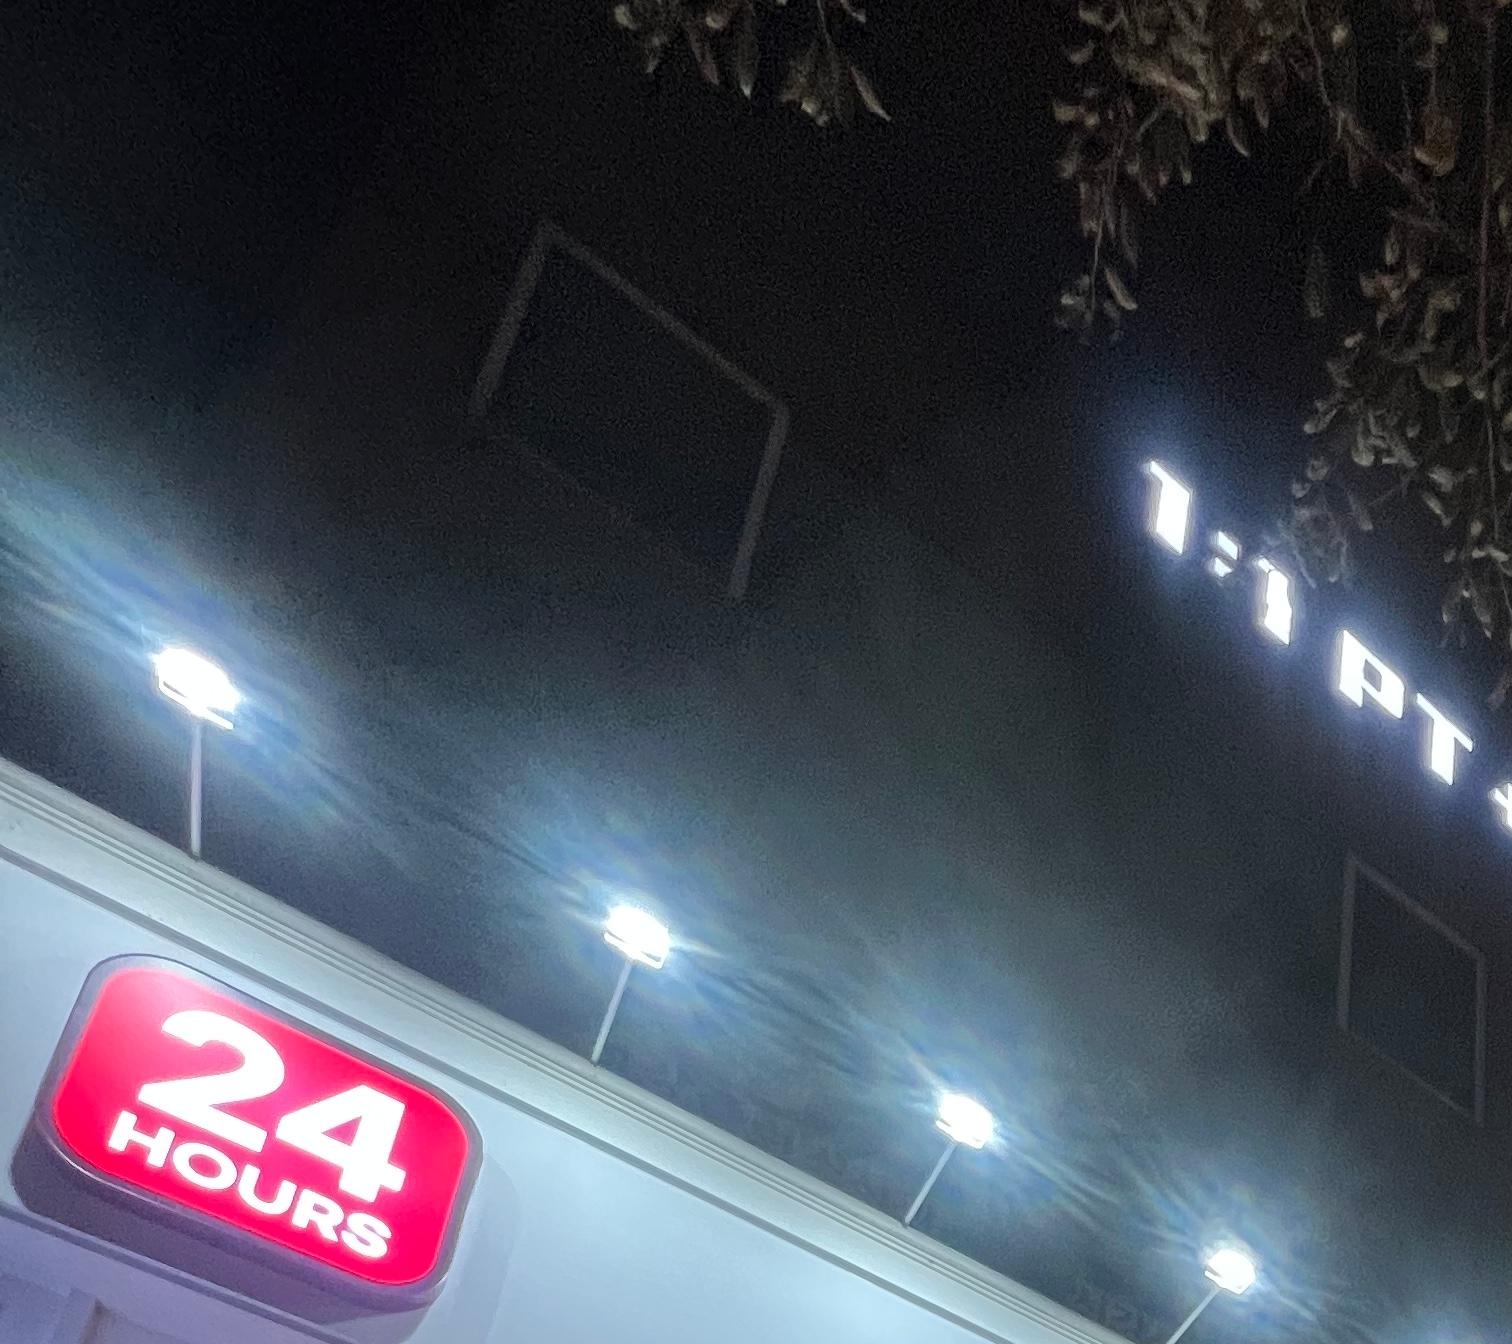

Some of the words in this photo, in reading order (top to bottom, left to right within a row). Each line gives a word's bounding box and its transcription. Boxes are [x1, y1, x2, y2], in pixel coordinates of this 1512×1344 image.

[1337, 628, 1474, 786] PT
[107, 1110, 393, 1260] HOURS
[137, 1009, 408, 1203] 24
